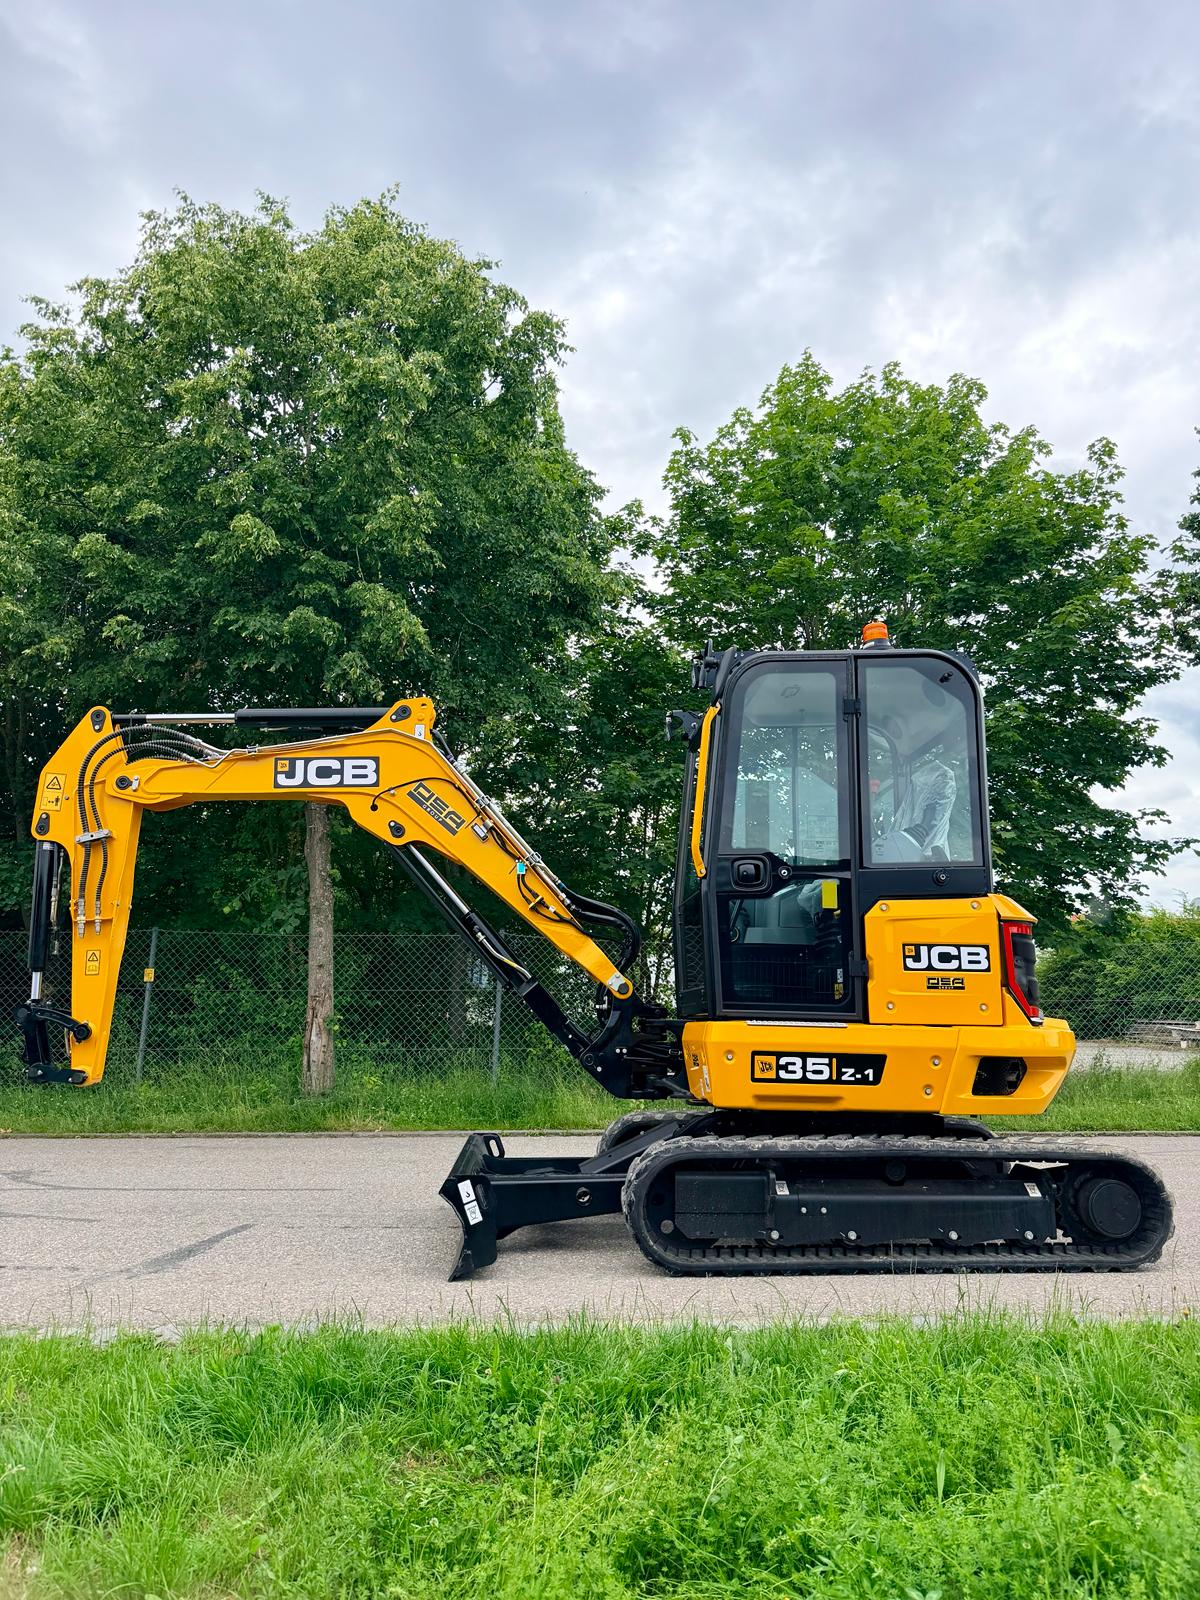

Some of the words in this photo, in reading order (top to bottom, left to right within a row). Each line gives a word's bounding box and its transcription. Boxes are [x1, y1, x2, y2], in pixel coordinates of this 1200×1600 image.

[276, 759, 378, 786] JCB
[413, 782, 466, 829] DEA
[422, 804, 443, 822] GROUP
[905, 945, 989, 970] JCB
[778, 1056, 830, 1080] 35
